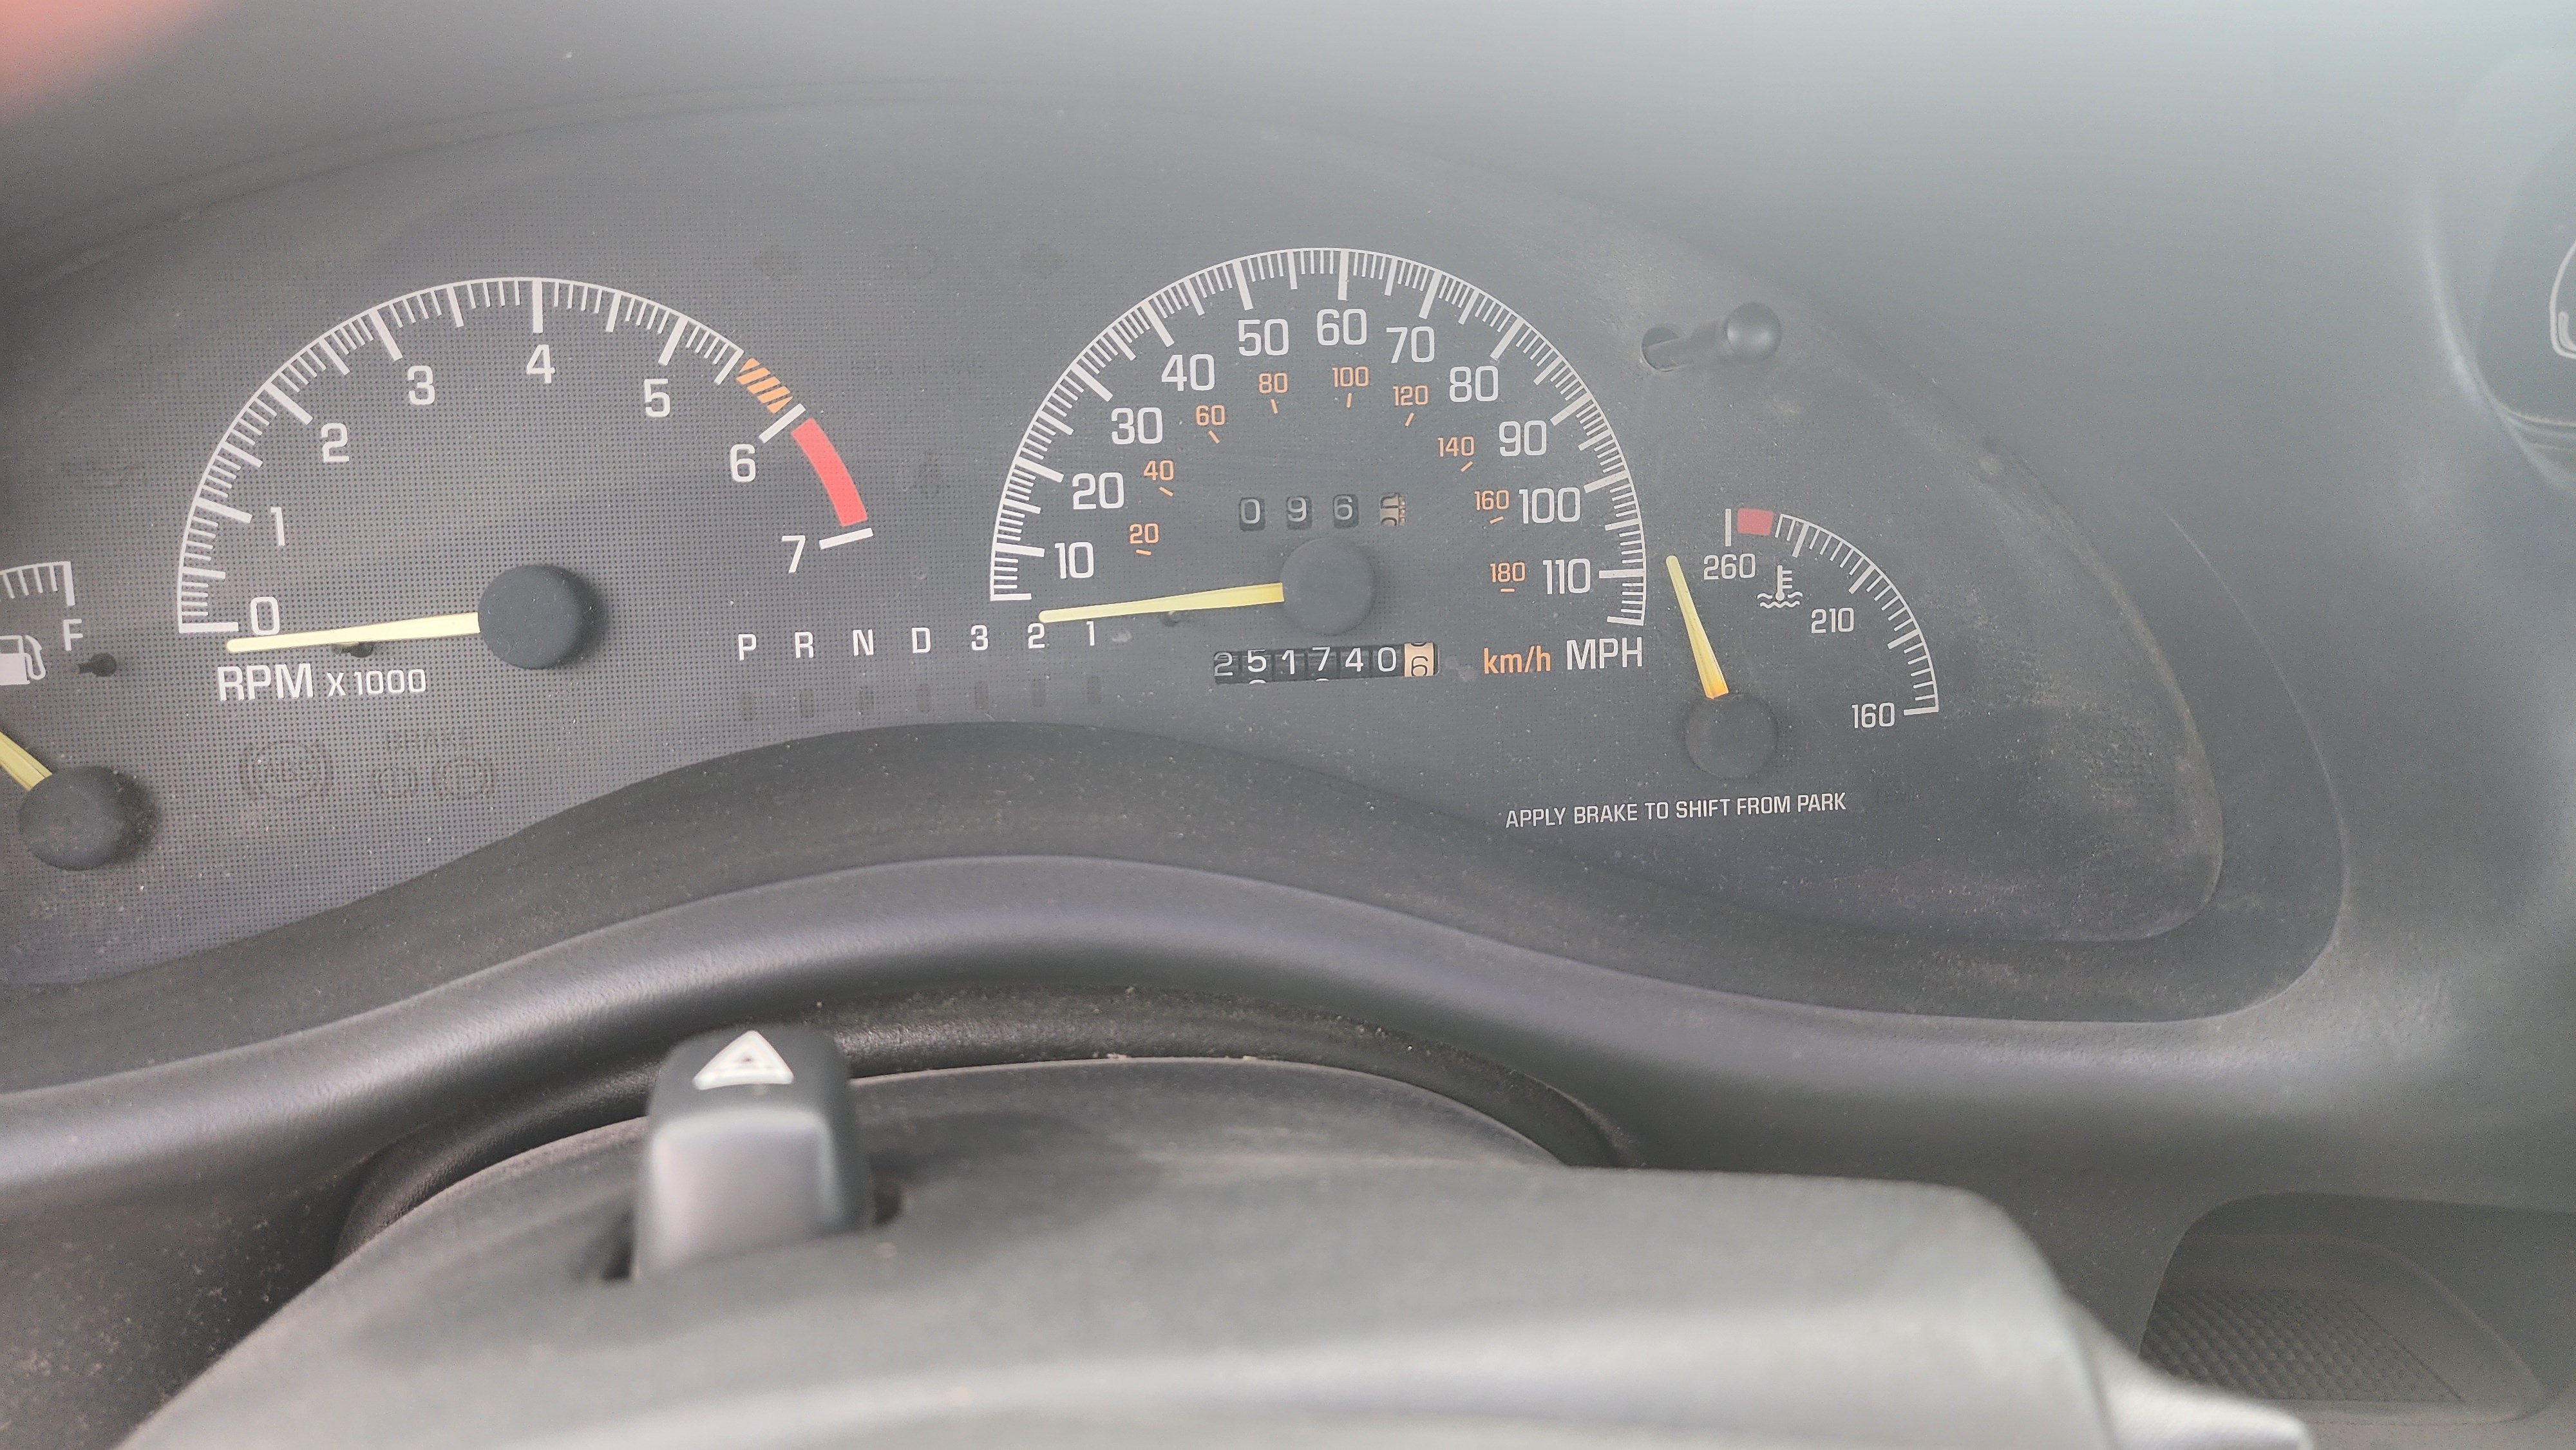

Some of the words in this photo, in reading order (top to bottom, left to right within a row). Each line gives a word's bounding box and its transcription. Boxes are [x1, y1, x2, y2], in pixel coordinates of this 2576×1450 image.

[1238, 318, 1289, 357] 50
[1316, 308, 1367, 346] 60
[1386, 326, 1435, 364] 70
[526, 344, 556, 384] 4
[1160, 353, 1215, 391] 40
[1332, 366, 1369, 388] 100
[406, 364, 435, 406] 3
[643, 378, 671, 419] 5
[1258, 372, 1288, 394] 80
[1392, 385, 1428, 406] 120
[1449, 365, 1499, 402] 80
[1111, 407, 1163, 445] 30
[1195, 404, 1226, 426] 60
[319, 422, 350, 464] 2
[1437, 436, 1475, 457] 140
[1499, 420, 1547, 457] 90
[729, 443, 756, 484] 6
[1143, 460, 1174, 481] 40
[1072, 472, 1124, 510] 20
[1474, 489, 1510, 511] 160
[1519, 487, 1581, 524] 100
[270, 506, 285, 548] 1
[1129, 523, 1159, 544] 20
[781, 534, 806, 574] 7
[1054, 541, 1094, 579] 10
[1490, 561, 1526, 583] 180
[1703, 553, 1756, 580] 260
[1542, 558, 1591, 595] 110
[62, 618, 84, 652] F
[249, 596, 281, 637] 0
[1811, 607, 1855, 634] 210
[737, 634, 757, 661] P
[794, 631, 814, 659] R
[852, 628, 874, 657] N
[911, 627, 931, 654] D
[971, 625, 989, 651] 3
[1027, 623, 1045, 649] 2
[1086, 621, 1095, 646] 1
[1483, 645, 1551, 674] km/h
[1566, 636, 1643, 670] MPH
[216, 663, 314, 702] RPM
[354, 668, 426, 696] 1000
[1852, 702, 1895, 729] 160
[1505, 807, 1566, 829] APPLY
[1574, 803, 1638, 824] BRAKE
[1644, 802, 1669, 820] TO
[1676, 798, 1731, 818] SHIFT
[1737, 795, 1790, 816] FROM
[1797, 792, 1847, 813] PARK
